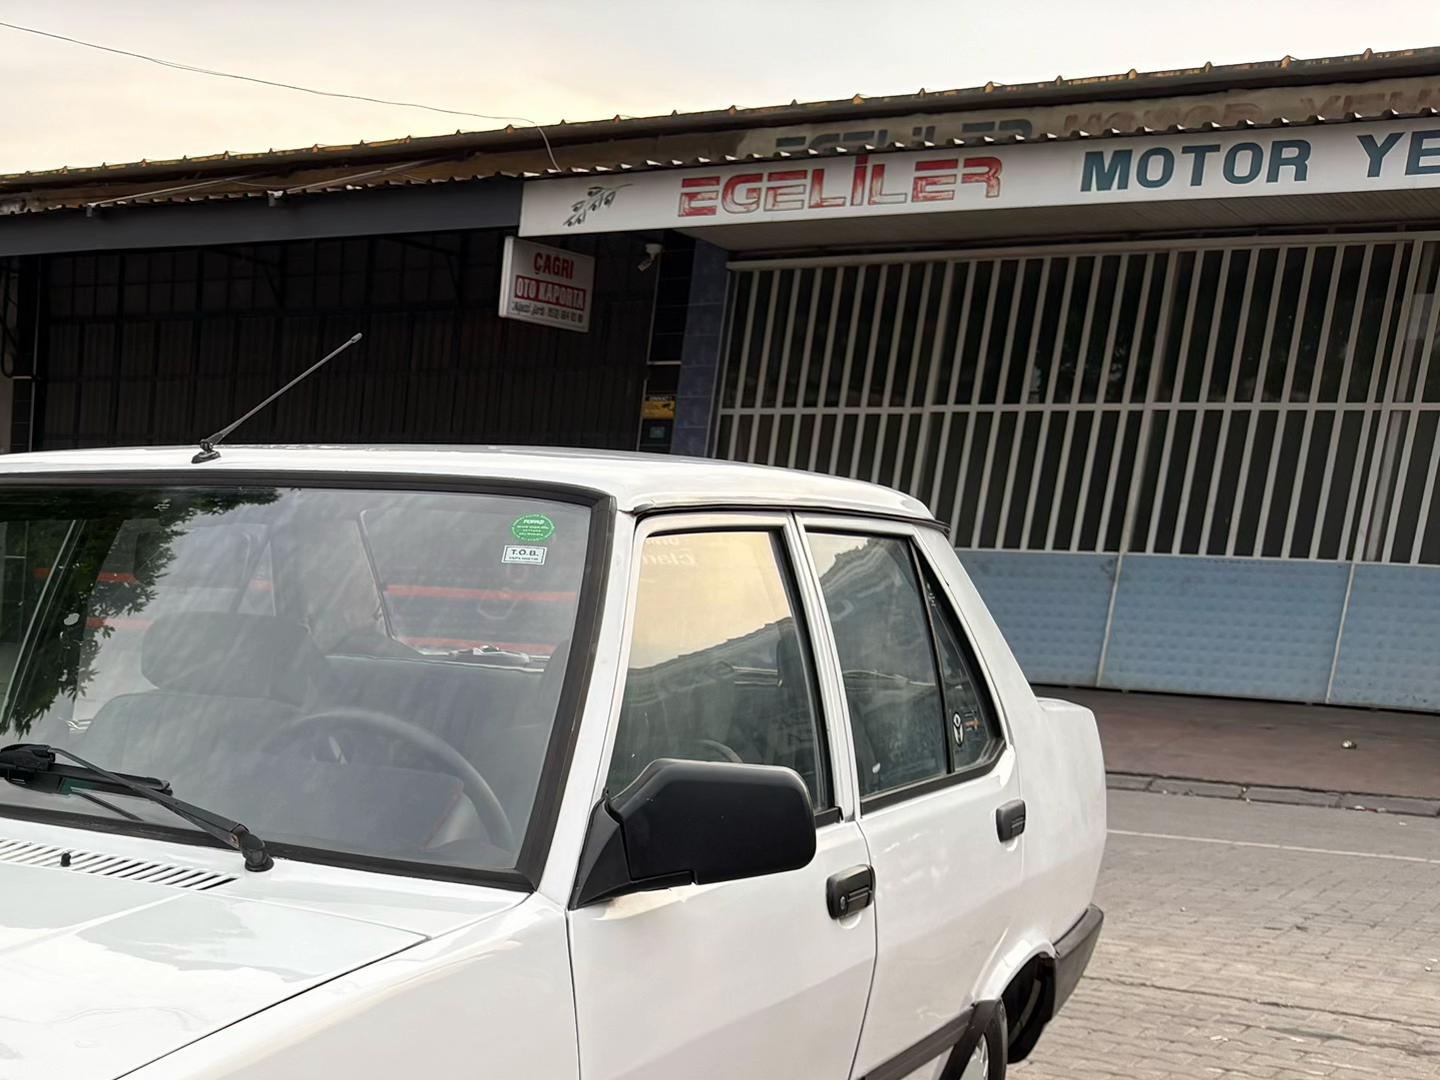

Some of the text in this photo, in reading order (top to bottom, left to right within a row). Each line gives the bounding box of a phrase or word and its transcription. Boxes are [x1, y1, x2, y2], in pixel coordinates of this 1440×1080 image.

[677, 155, 1003, 217] EGELİLER
[1080, 139, 1311, 192] MOTOR
[516, 277, 537, 300] OTO
